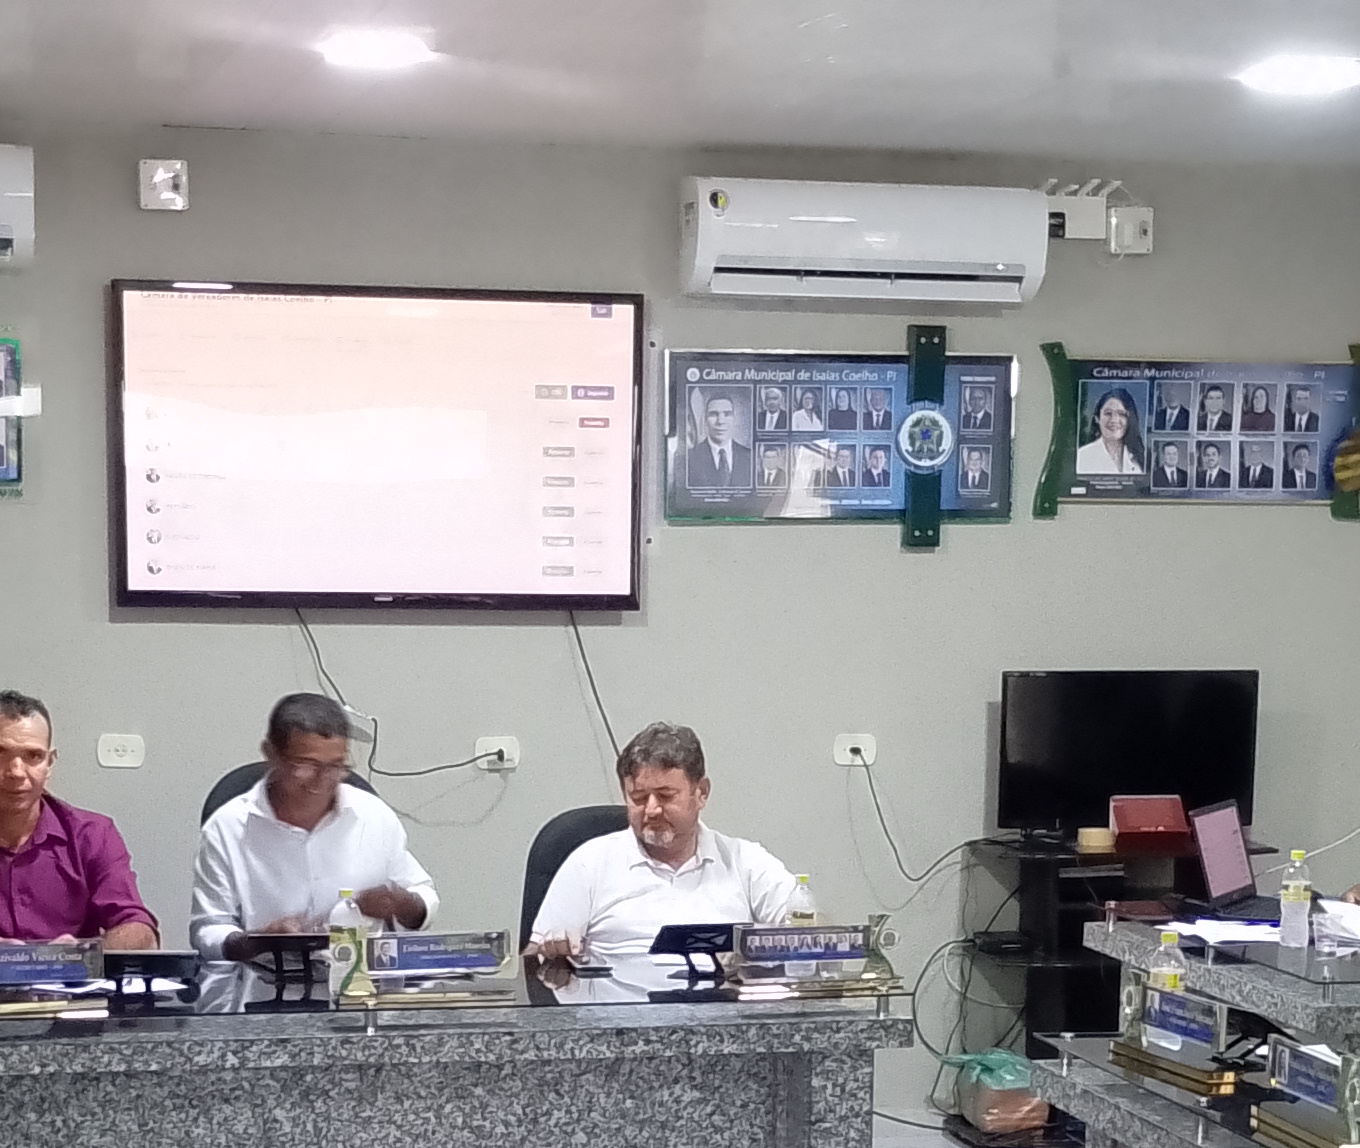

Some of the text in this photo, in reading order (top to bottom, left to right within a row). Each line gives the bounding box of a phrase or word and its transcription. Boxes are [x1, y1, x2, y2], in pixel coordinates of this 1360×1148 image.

[702, 368, 742, 380] Câmara
[744, 368, 795, 383] Municipal
[796, 369, 811, 380] de
[842, 369, 878, 381] Coelho
[886, 370, 897, 381] PI
[1093, 366, 1140, 377] Câmara
[1143, 367, 1204, 379] Municipal
[1313, 370, 1326, 379] PI
